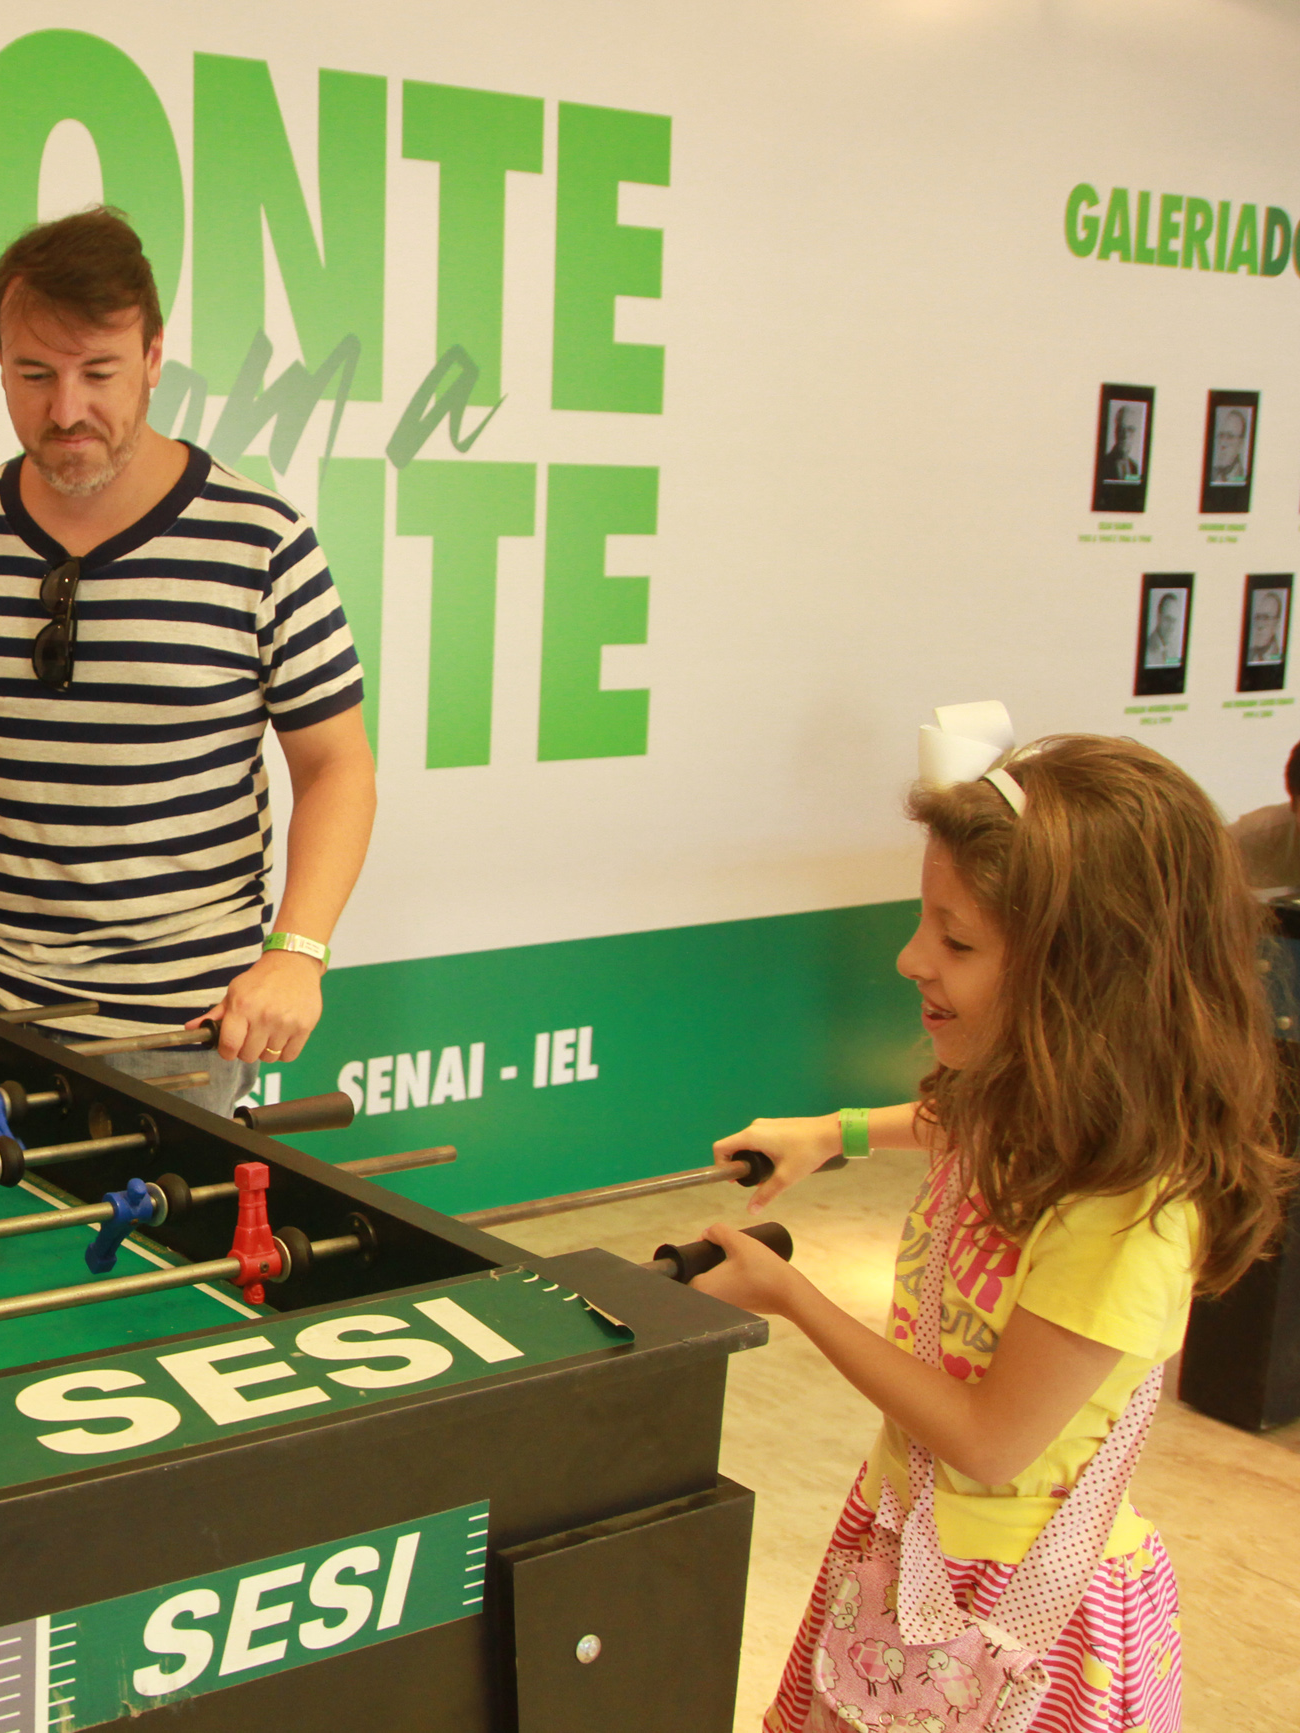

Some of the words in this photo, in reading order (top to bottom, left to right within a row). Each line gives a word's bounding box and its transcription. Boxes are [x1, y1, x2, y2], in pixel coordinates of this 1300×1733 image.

[337, 1041, 486, 1116] SENAI
[532, 1025, 599, 1089] IEL
[15, 1297, 525, 1455] SESI
[132, 1531, 421, 1697] SESI
